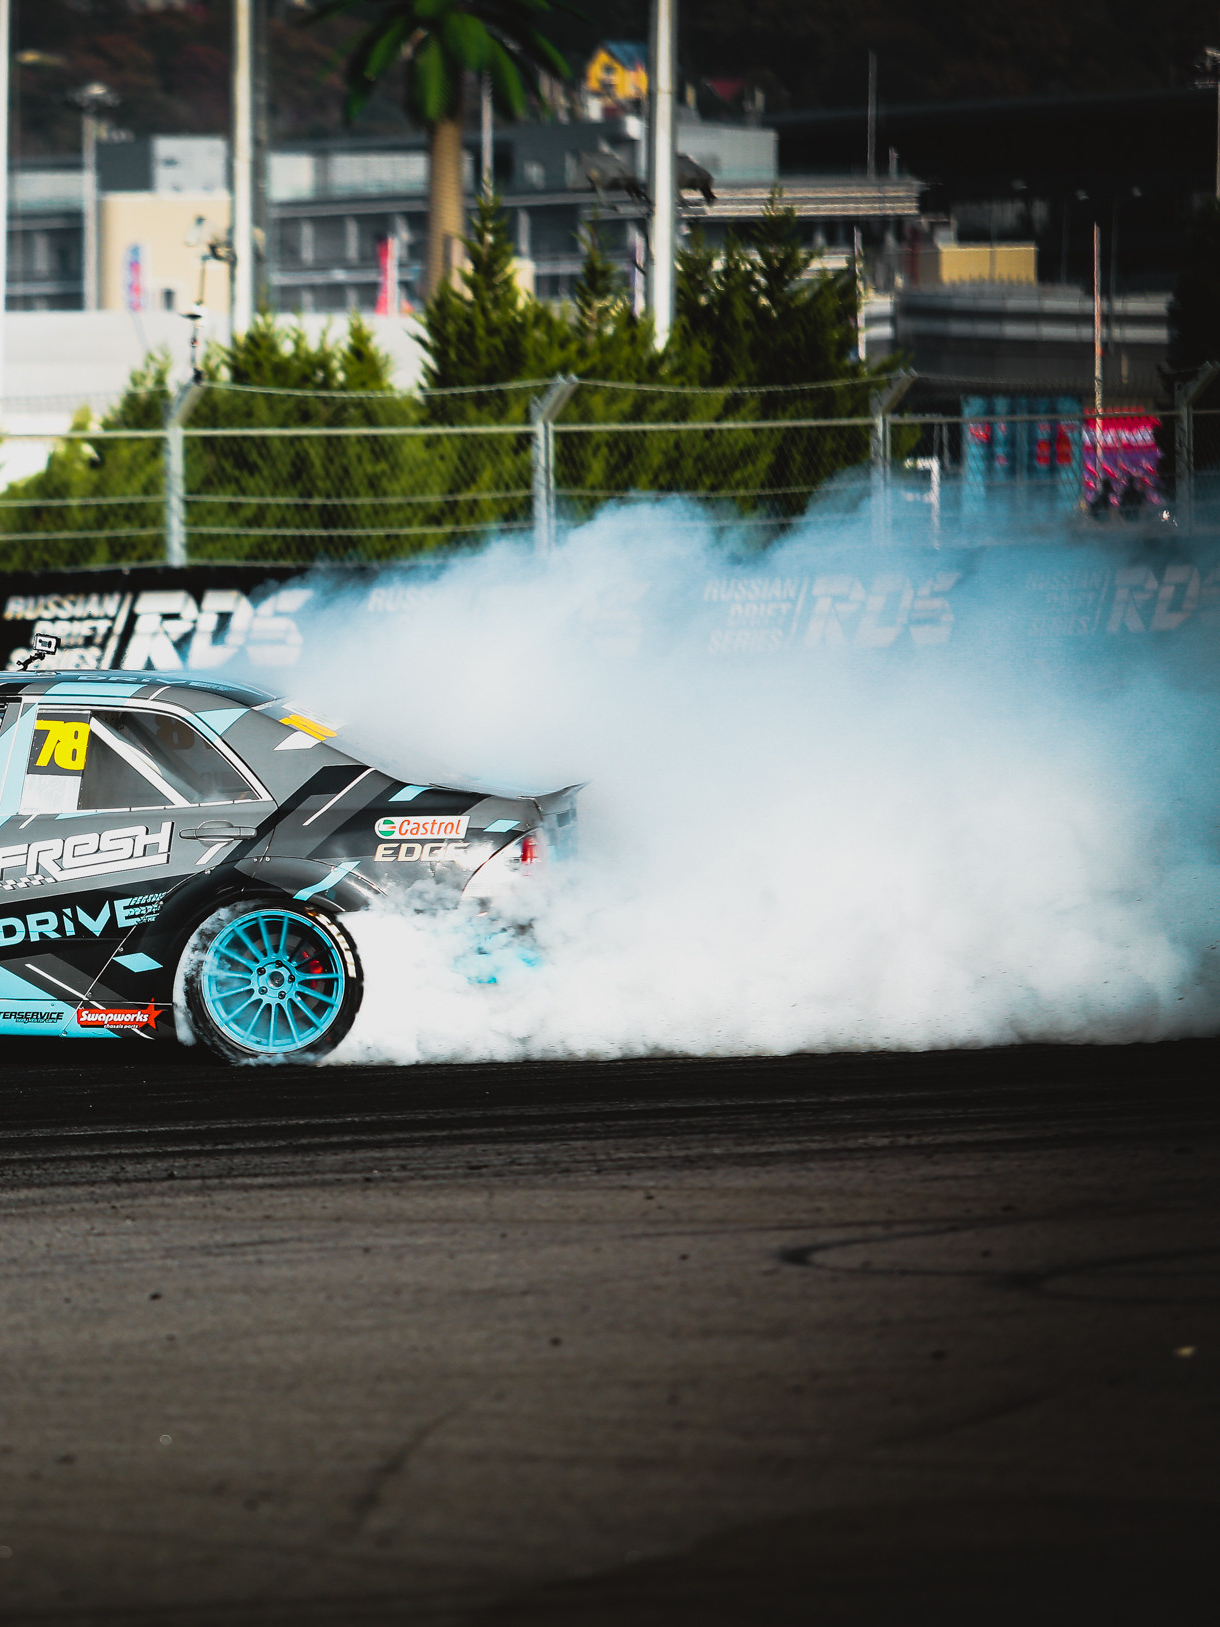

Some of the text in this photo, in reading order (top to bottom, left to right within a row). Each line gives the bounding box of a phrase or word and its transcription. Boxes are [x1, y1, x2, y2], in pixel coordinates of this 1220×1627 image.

[3, 593, 121, 620] RUSSIAN
[804, 571, 961, 648] RDS
[120, 589, 313, 670] RDS
[35, 720, 91, 770] 78
[398, 819, 462, 836] Castrol
[374, 842, 470, 862] EDGE
[79, 1010, 150, 1023] Swapworks
